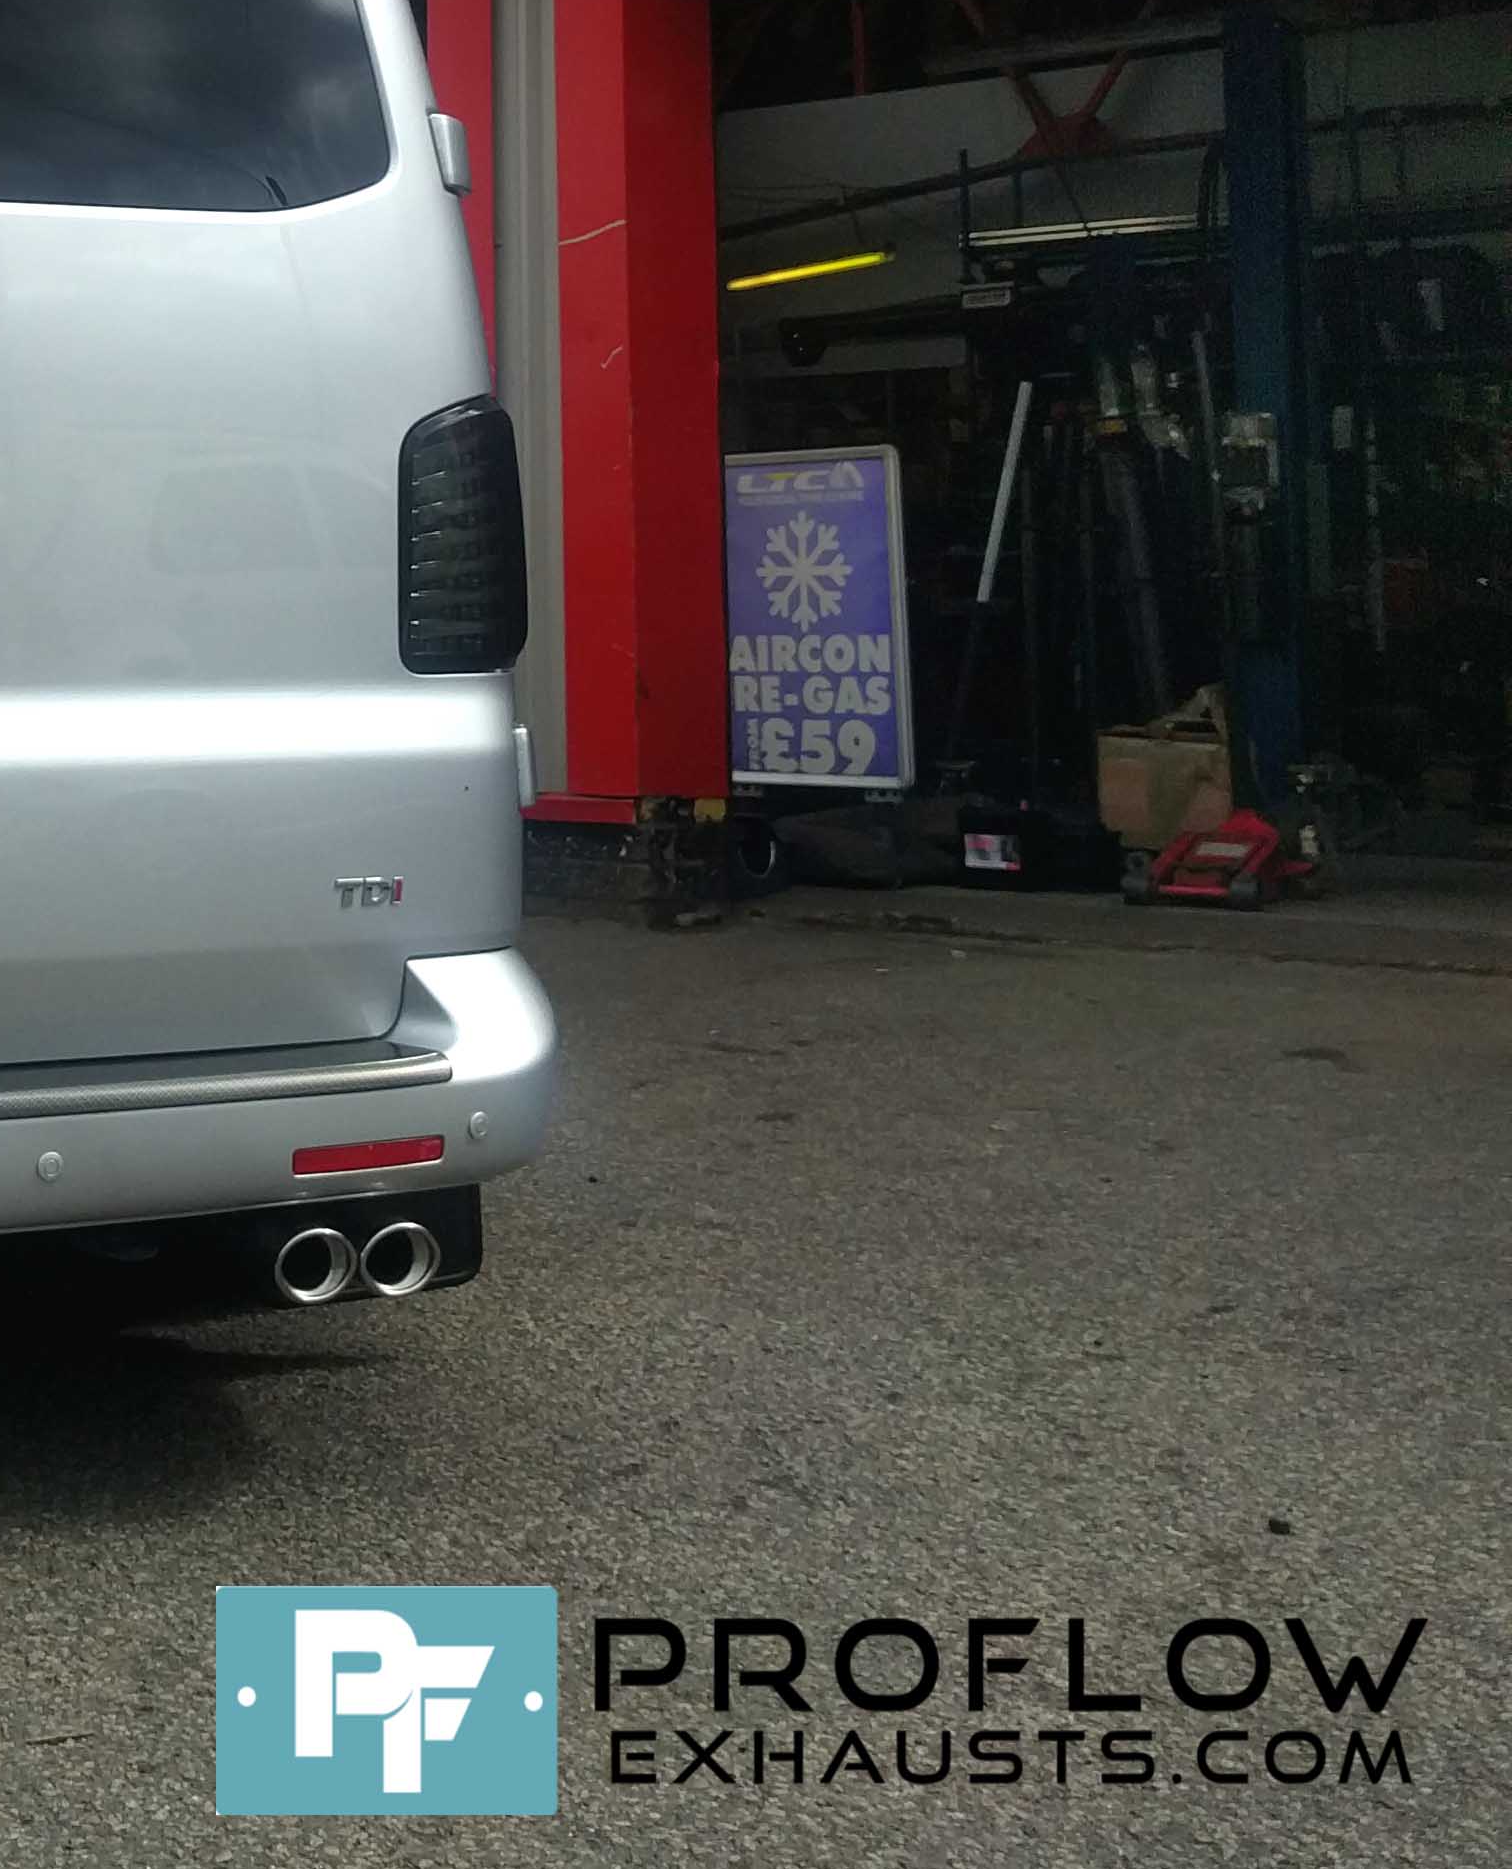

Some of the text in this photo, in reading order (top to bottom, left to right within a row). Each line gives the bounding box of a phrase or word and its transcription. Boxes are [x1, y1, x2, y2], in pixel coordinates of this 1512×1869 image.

[729, 634, 891, 673] AIRCON
[733, 675, 892, 715] RE-GAS
[760, 717, 876, 775] £59
